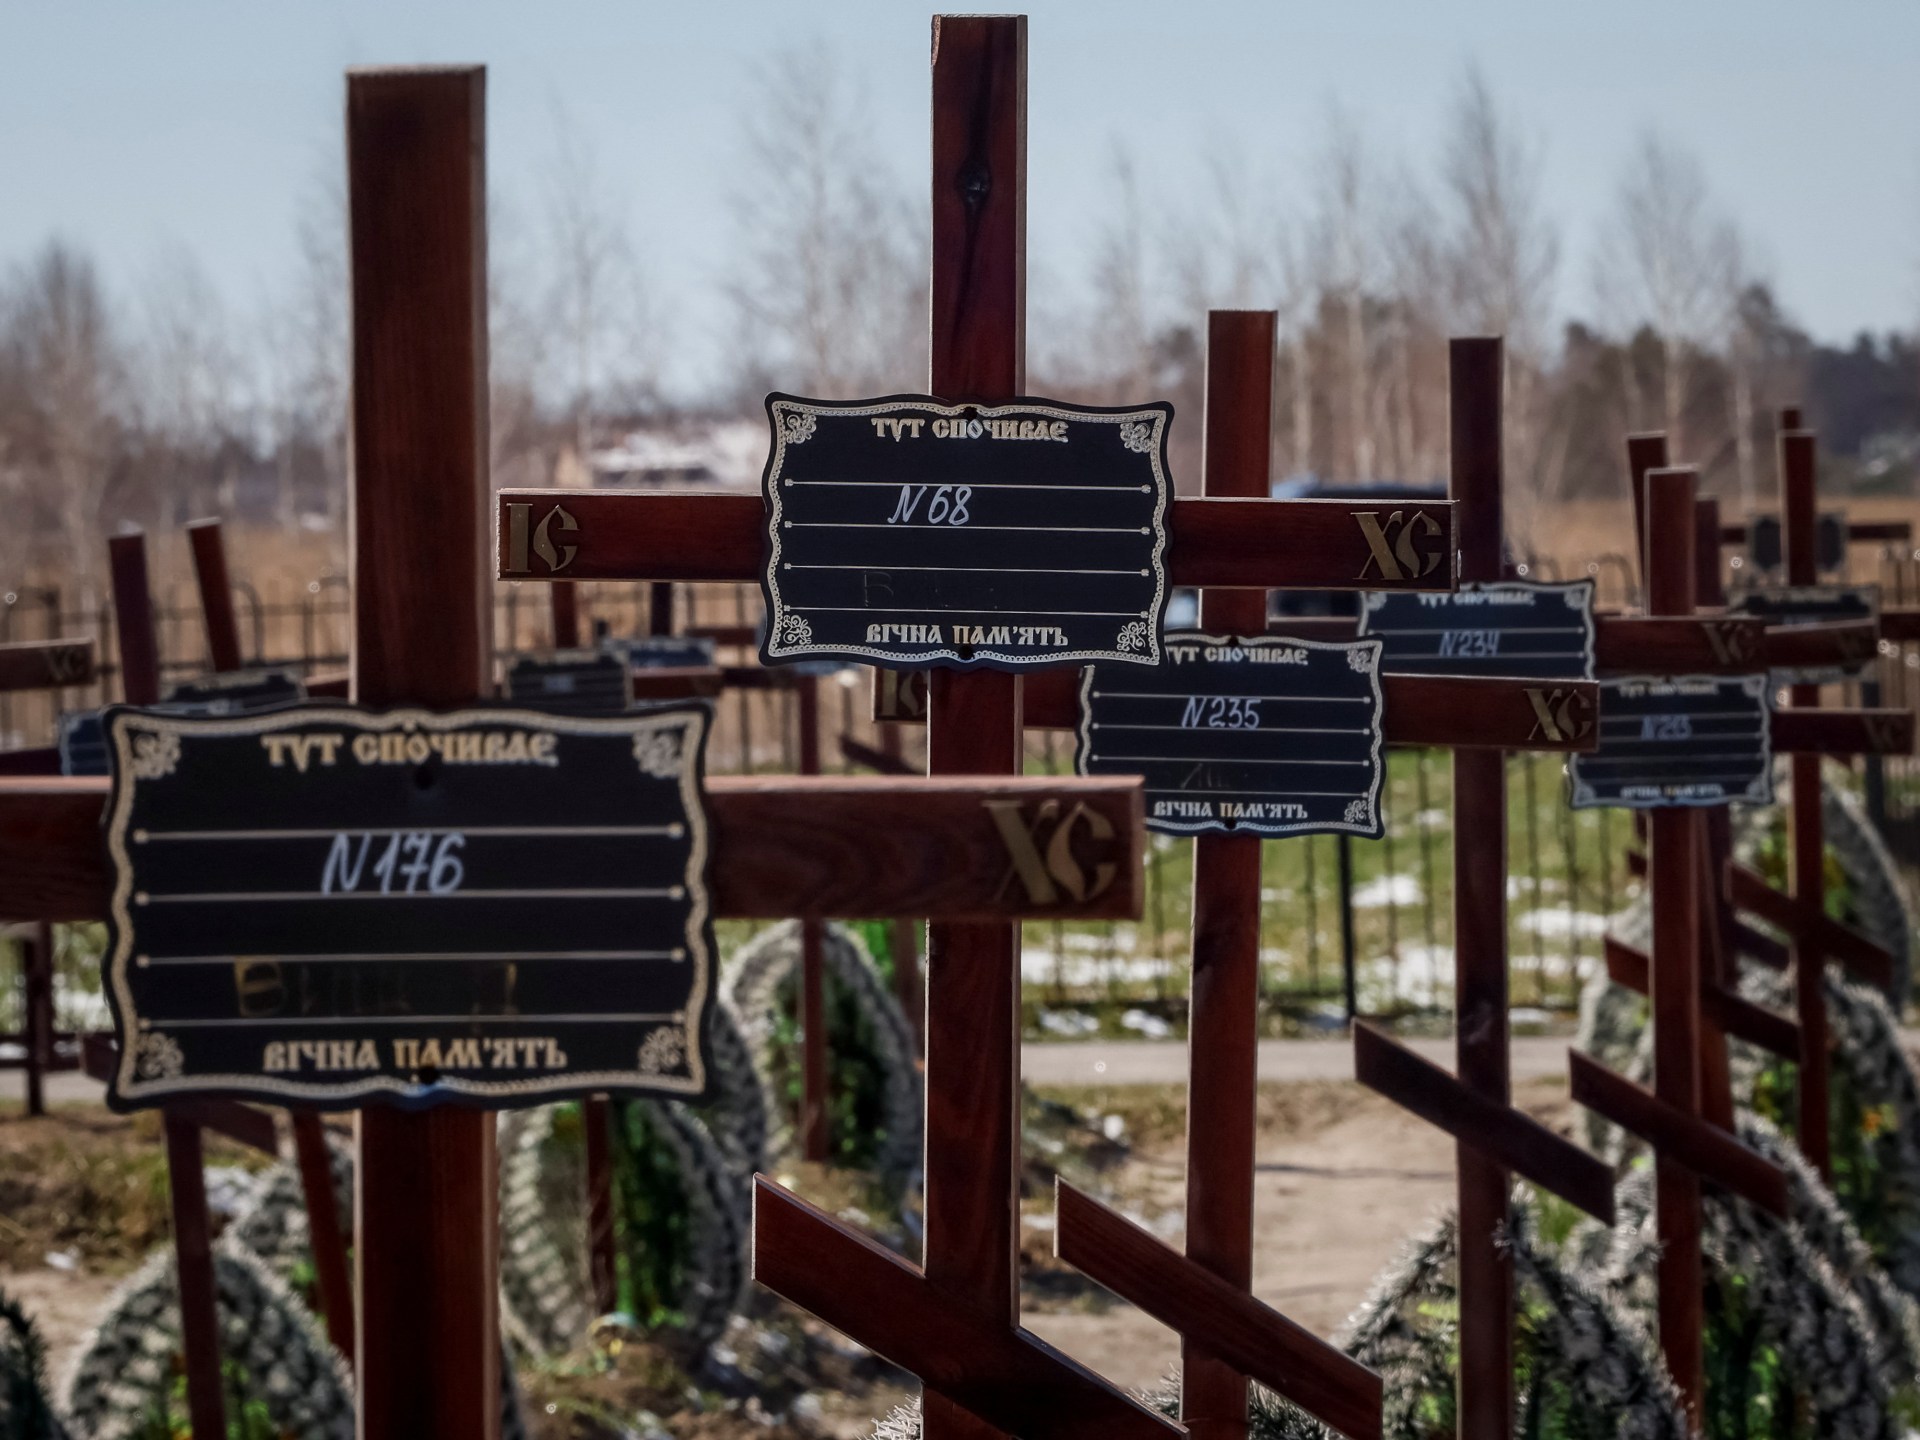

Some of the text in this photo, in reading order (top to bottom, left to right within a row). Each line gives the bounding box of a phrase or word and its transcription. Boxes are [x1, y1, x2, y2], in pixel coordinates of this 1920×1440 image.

[871, 418, 1069, 443] ТУТ СПОЧИВАЄ
[865, 623, 1069, 646] ВІЧНА ПАМ'ЯТЬ
[261, 732, 559, 773] ТУТ СПОЧИВАЄ
[1153, 801, 1308, 819] ВІЧНА ПАМ'ЯТЬ
[262, 1037, 568, 1072] ВІЧНА ПАМ'ЯТЬ
